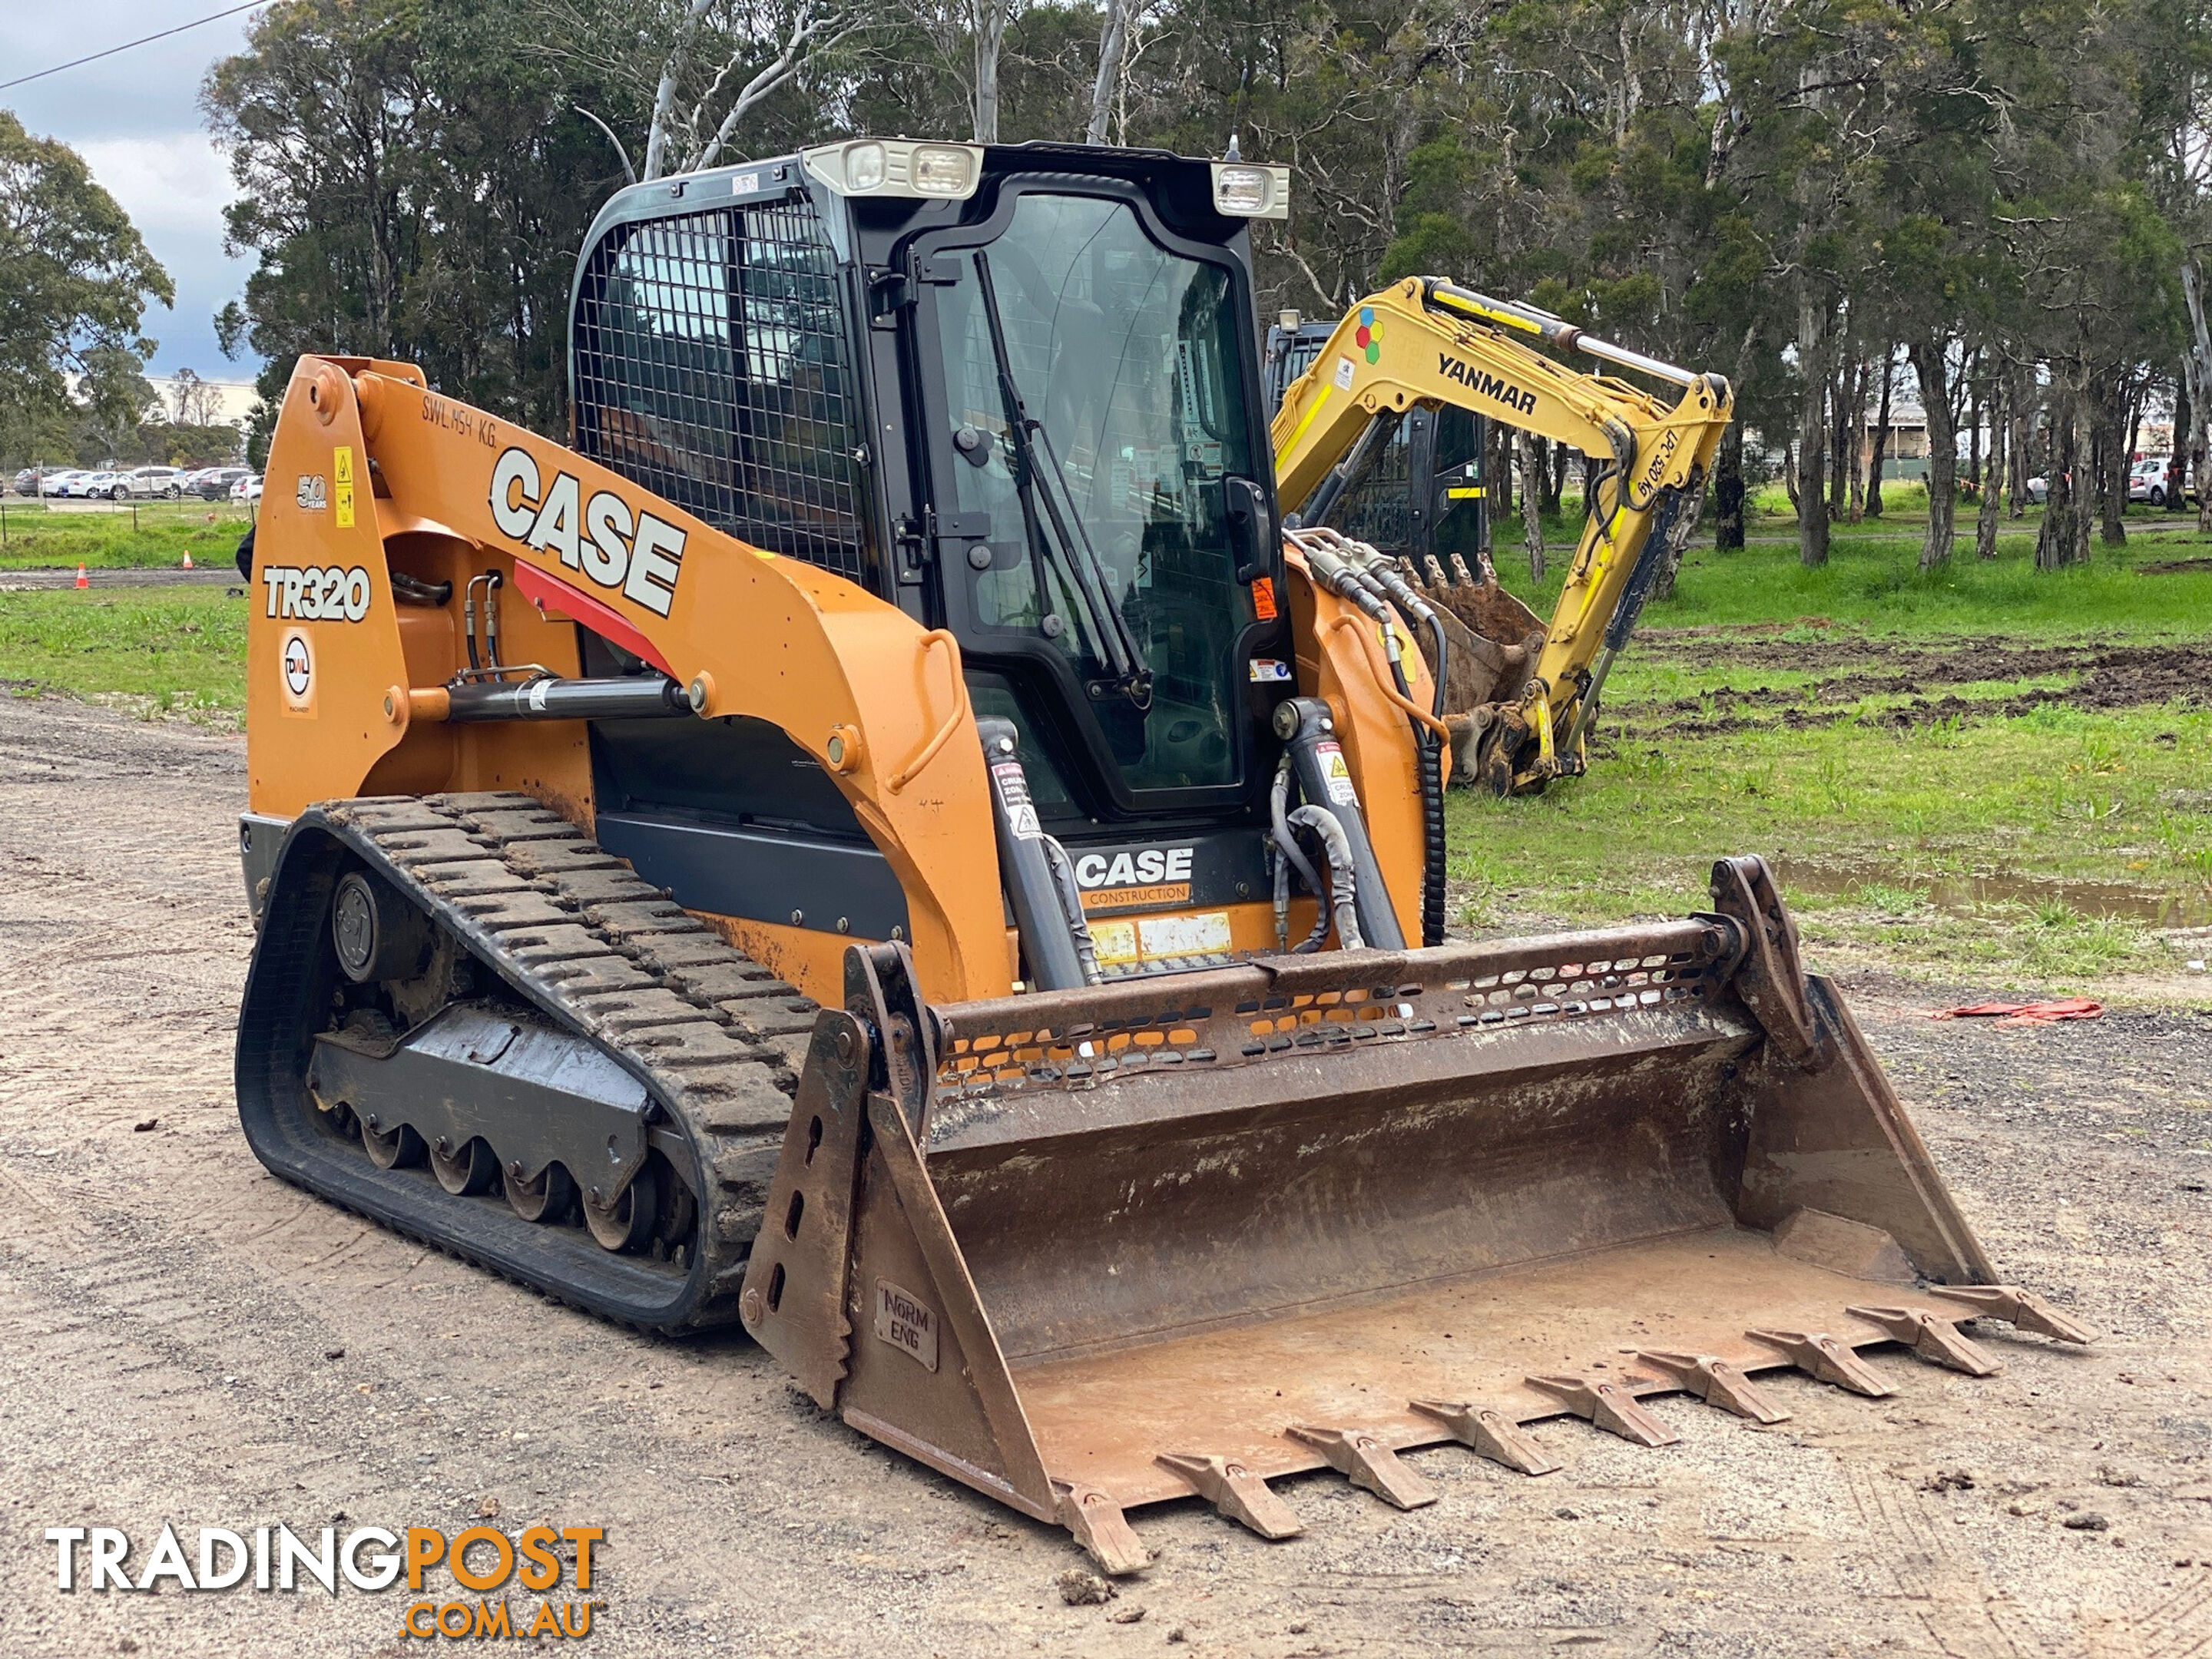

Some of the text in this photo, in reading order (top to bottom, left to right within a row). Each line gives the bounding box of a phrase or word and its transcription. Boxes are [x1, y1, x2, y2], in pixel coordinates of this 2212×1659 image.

[1439, 352, 1537, 416] YANMAR
[1661, 429, 1678, 459] LPC
[1648, 455, 1665, 482] 520
[296, 474, 326, 508] 50
[489, 445, 687, 620] CASE
[263, 565, 371, 624] TR320
[1076, 847, 1194, 888] CASE
[1090, 886, 1186, 906] CONSTRUCTION
[891, 1320, 919, 1350] ENG
